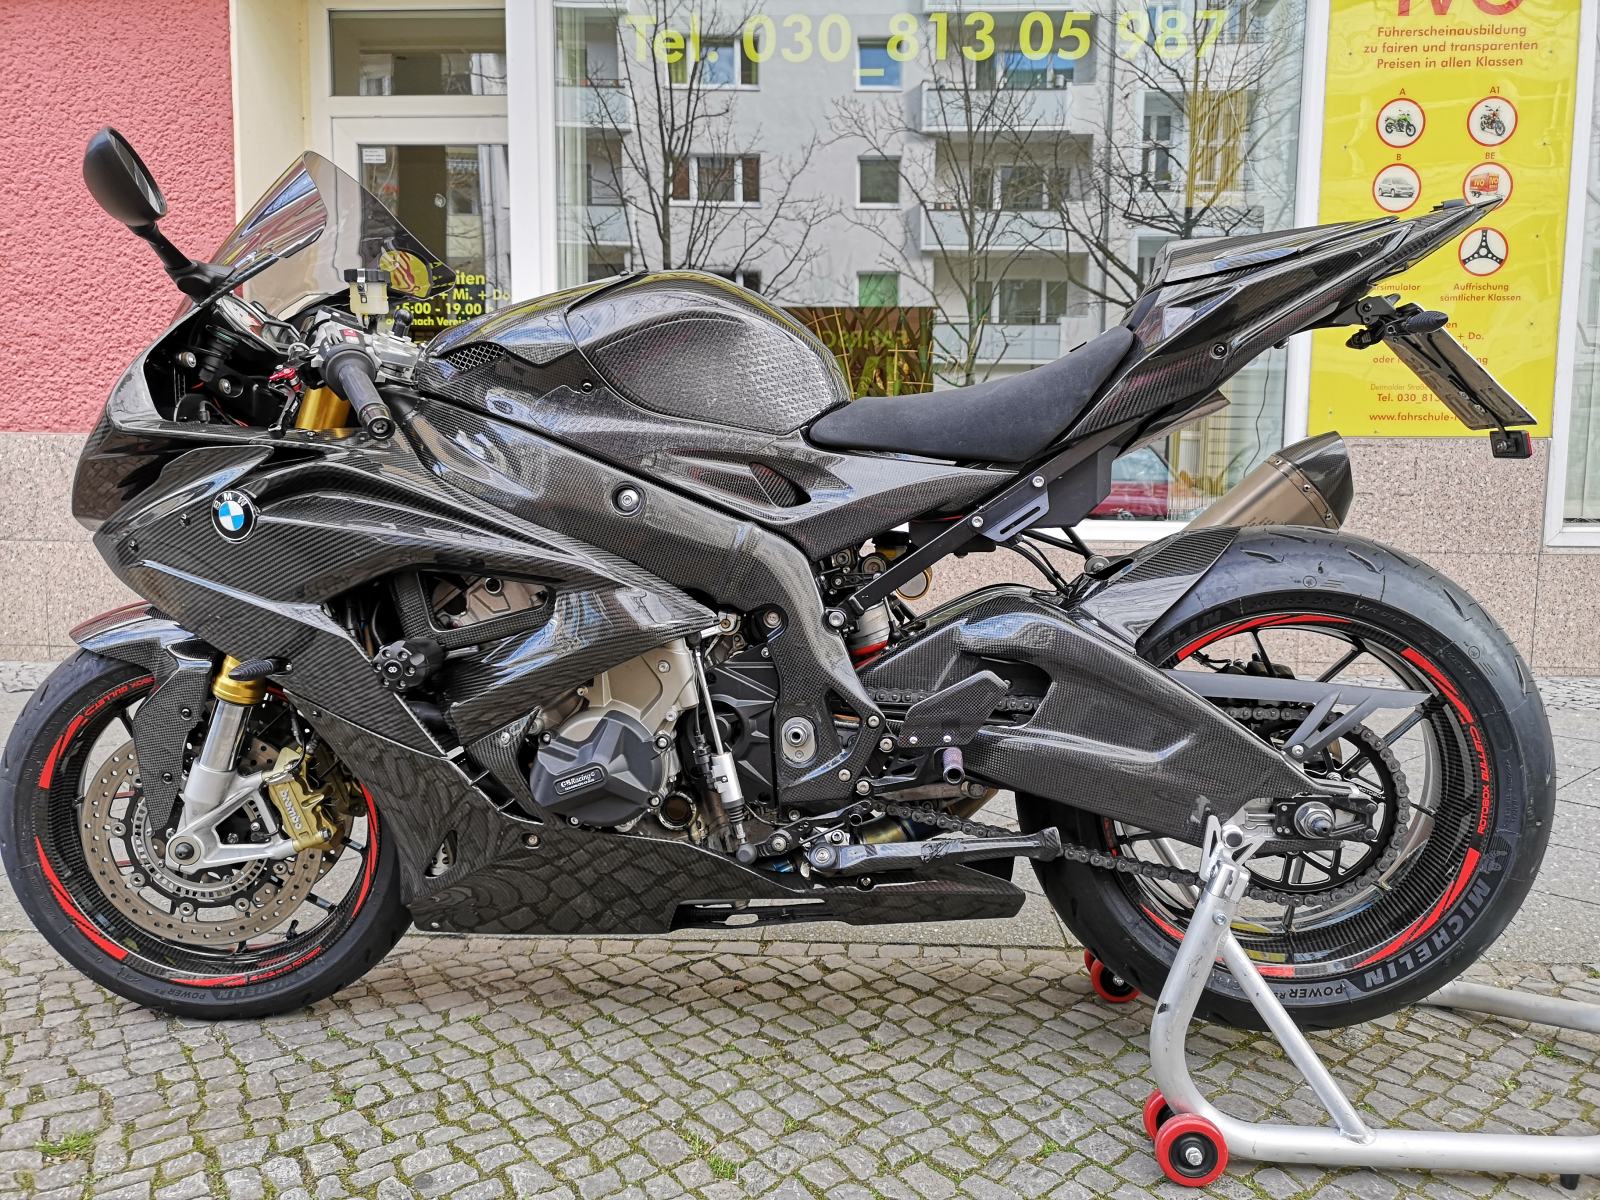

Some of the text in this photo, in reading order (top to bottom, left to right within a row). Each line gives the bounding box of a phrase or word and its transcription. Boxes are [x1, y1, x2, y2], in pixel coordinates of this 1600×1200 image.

[625, 13, 719, 63] Tel.
[1019, 11, 1091, 60] 05
[1116, 10, 1229, 59] 987
[1377, 25, 1527, 37] Führerscheinausbildung
[1364, 40, 1538, 53] zu fairen und transparenten
[1377, 56, 1523, 68] Preisen in allen Klassen
[1399, 87, 1406, 95] A
[1489, 86, 1500, 94] A1
[1485, 152, 1495, 160] BE
[1453, 283, 1509, 292] Auffrischung
[453, 288, 473, 300] Mi.
[1440, 293, 1521, 302] sämtlicher Klassen
[446, 303, 482, 315] 19.00
[1468, 332, 1484, 340] Do.
[1373, 356, 1394, 364] oder
[1377, 394, 1393, 402] Tel.
[213, 492, 248, 510] BMW
[1477, 784, 1490, 836] ROTOBOX
[1364, 877, 1491, 989] MICHELIN
[1289, 982, 1344, 998] POWER
